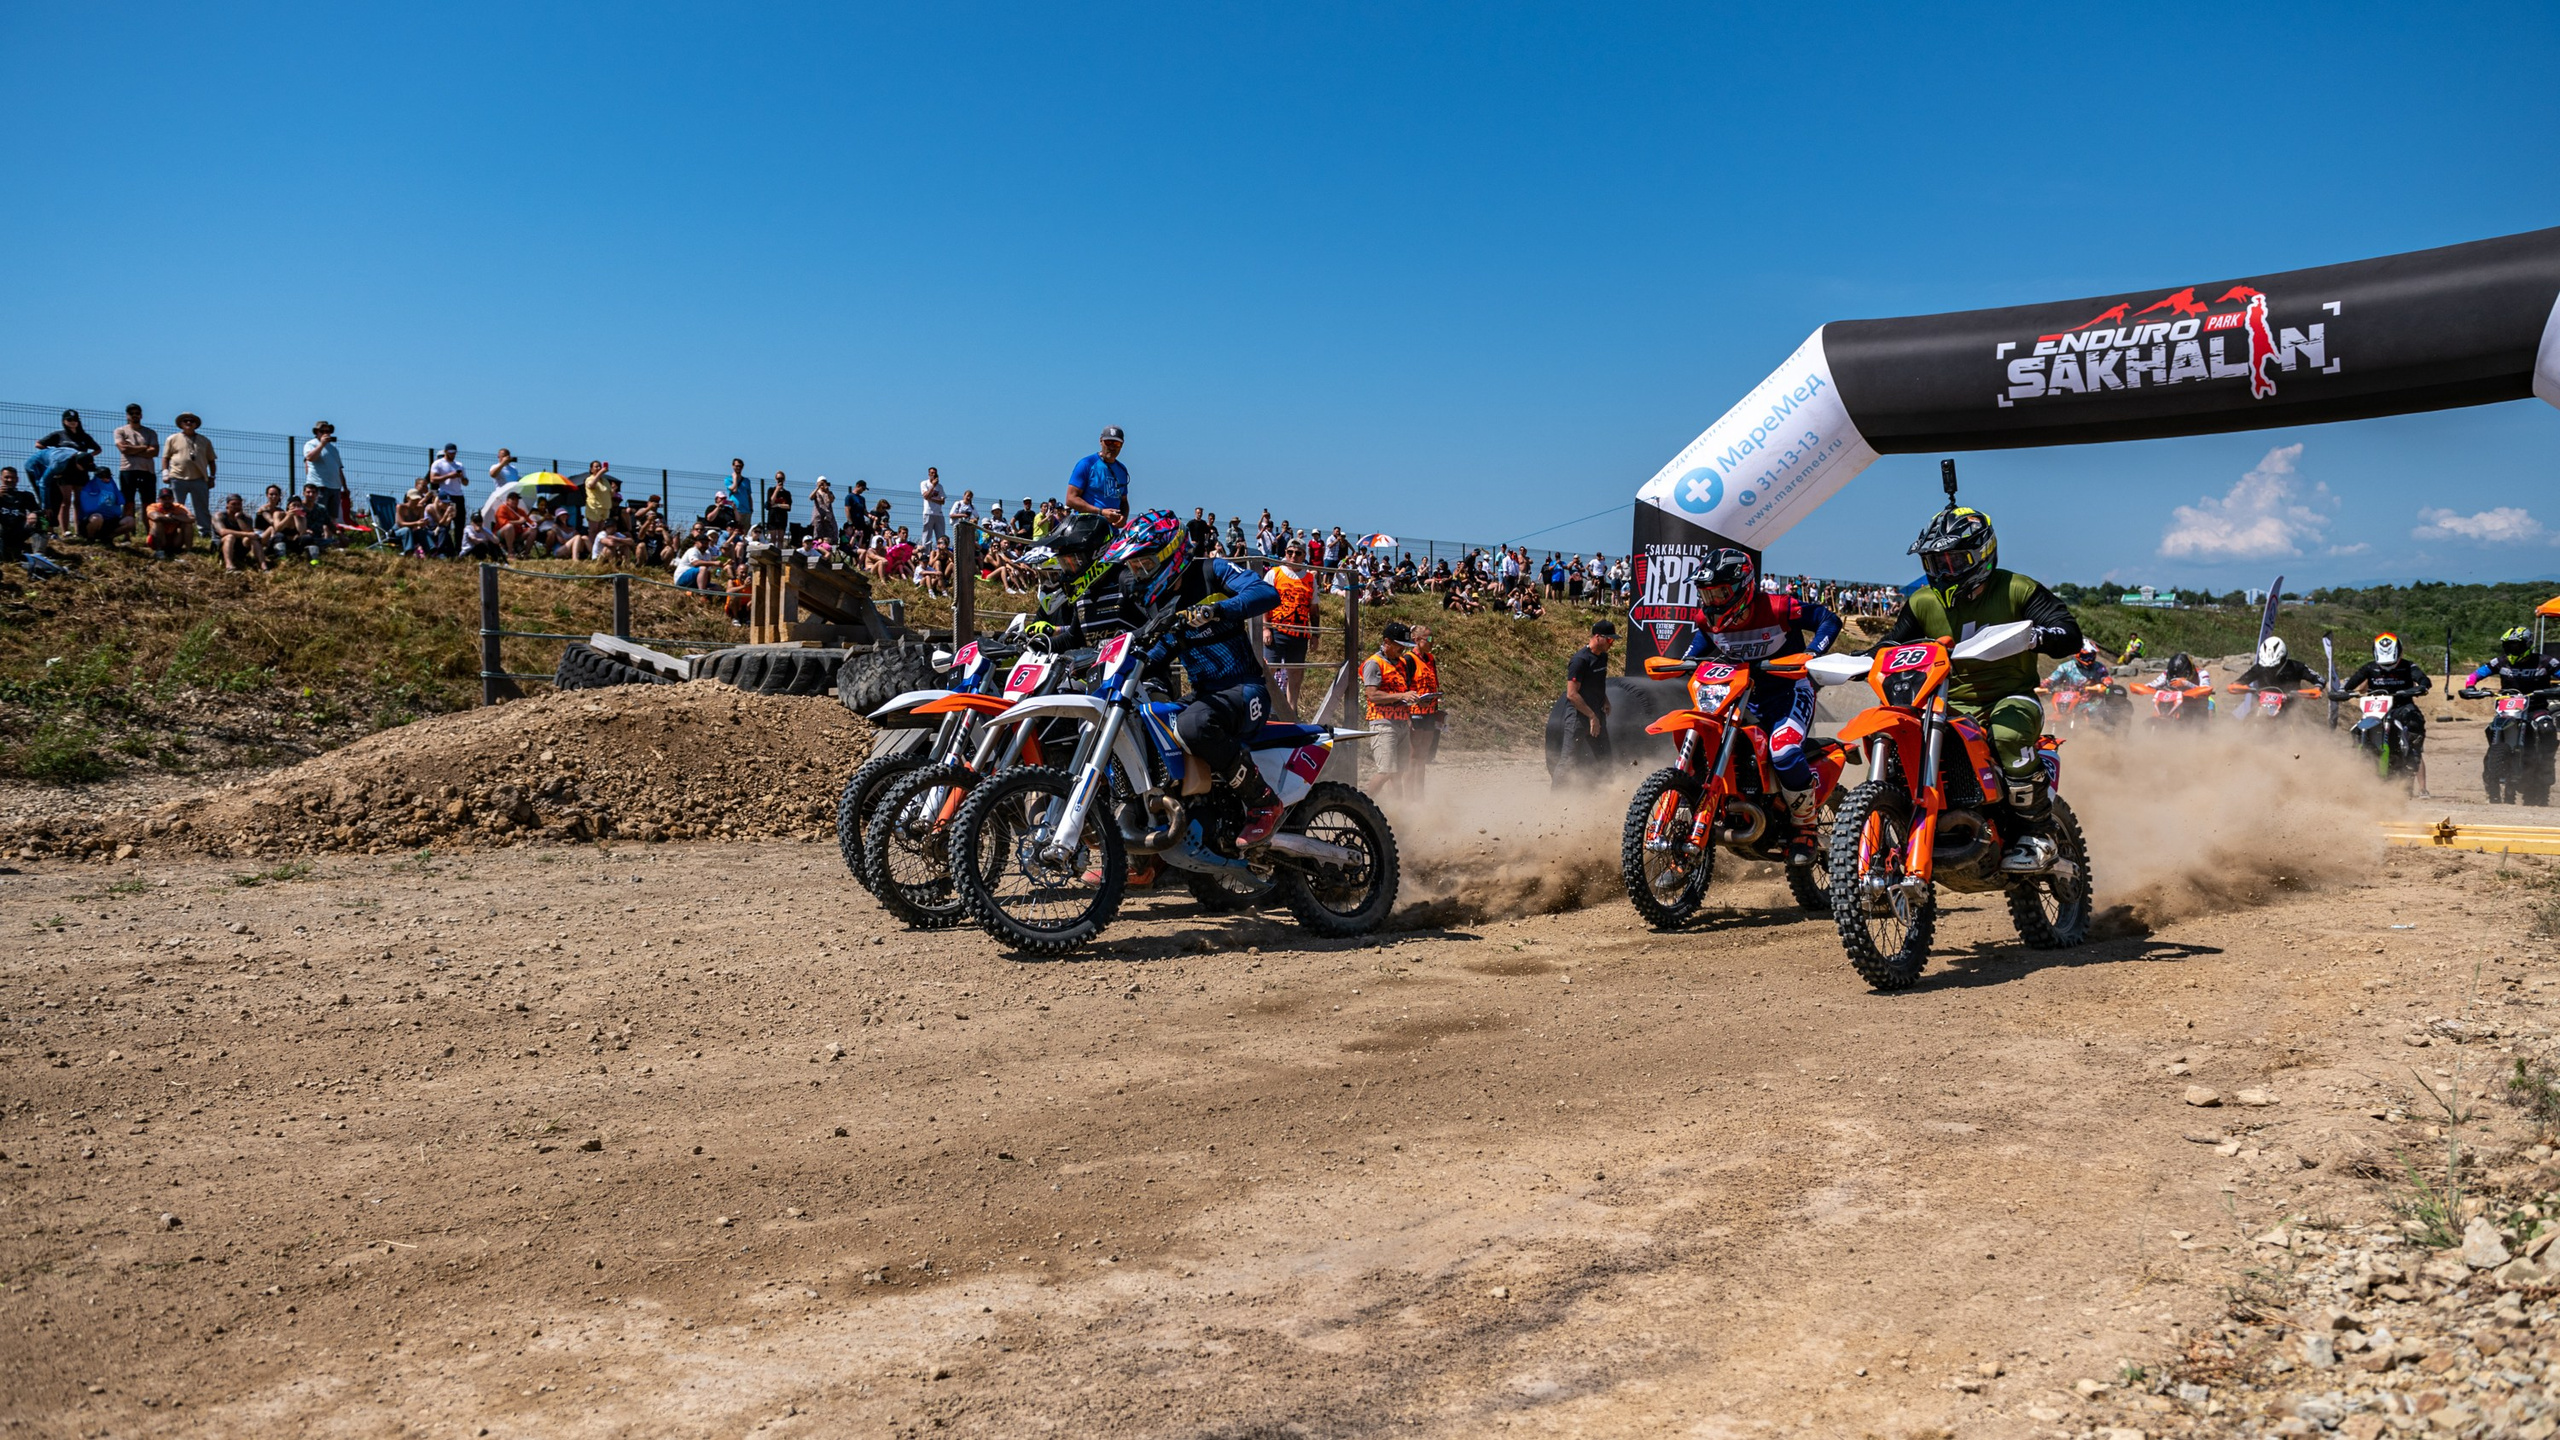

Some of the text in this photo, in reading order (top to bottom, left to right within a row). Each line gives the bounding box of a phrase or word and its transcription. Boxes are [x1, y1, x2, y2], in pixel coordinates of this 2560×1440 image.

[2033, 315, 2241, 357] ENDURO PARK
[2007, 300, 2325, 399] SAKHALIN
[1716, 373, 1826, 474] МареМед
[1757, 430, 1820, 491] 31-13-13
[1745, 438, 1843, 527] www.maremed.ru
[1649, 544, 1701, 556] SAKHALIN
[1644, 606, 1671, 620] PLACE
[1674, 606, 1687, 620] TO
[1889, 649, 1928, 670] 28
[1014, 670, 1029, 687] 6
[1703, 665, 1735, 679] 46
[2506, 700, 2516, 708] 9
[1301, 751, 1316, 770] 1
